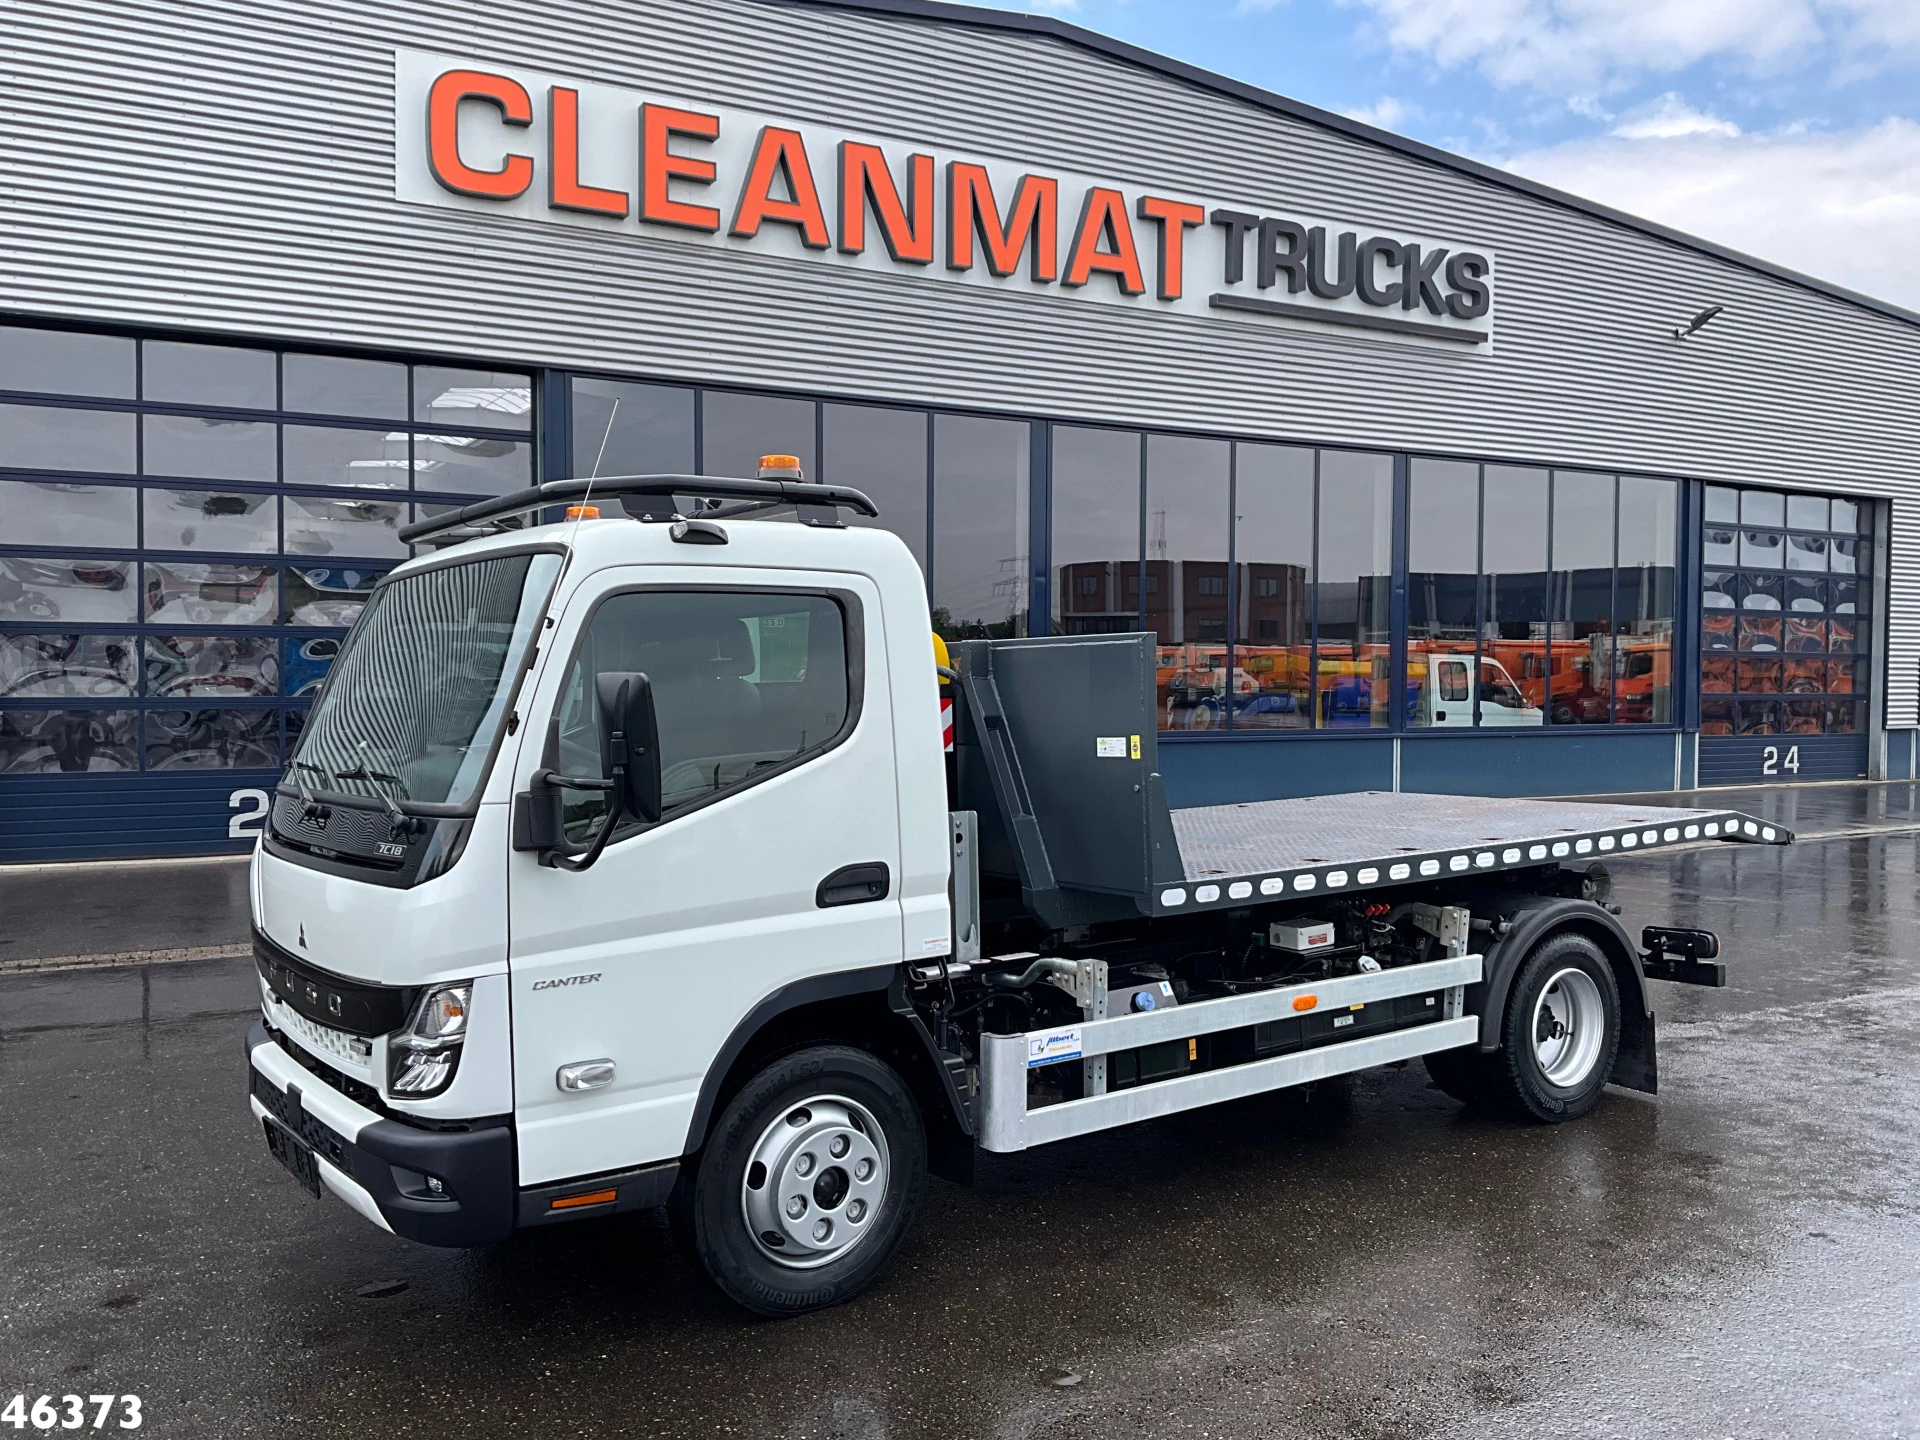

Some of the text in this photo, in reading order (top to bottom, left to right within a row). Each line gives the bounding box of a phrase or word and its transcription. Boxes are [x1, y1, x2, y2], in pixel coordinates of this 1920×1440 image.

[426, 68, 1490, 320] CLEANMAT TRUCKS
[1763, 745, 1800, 775] 24
[379, 844, 403, 856] 7C18
[269, 959, 342, 1017] FUSO
[532, 972, 602, 991] CANTER
